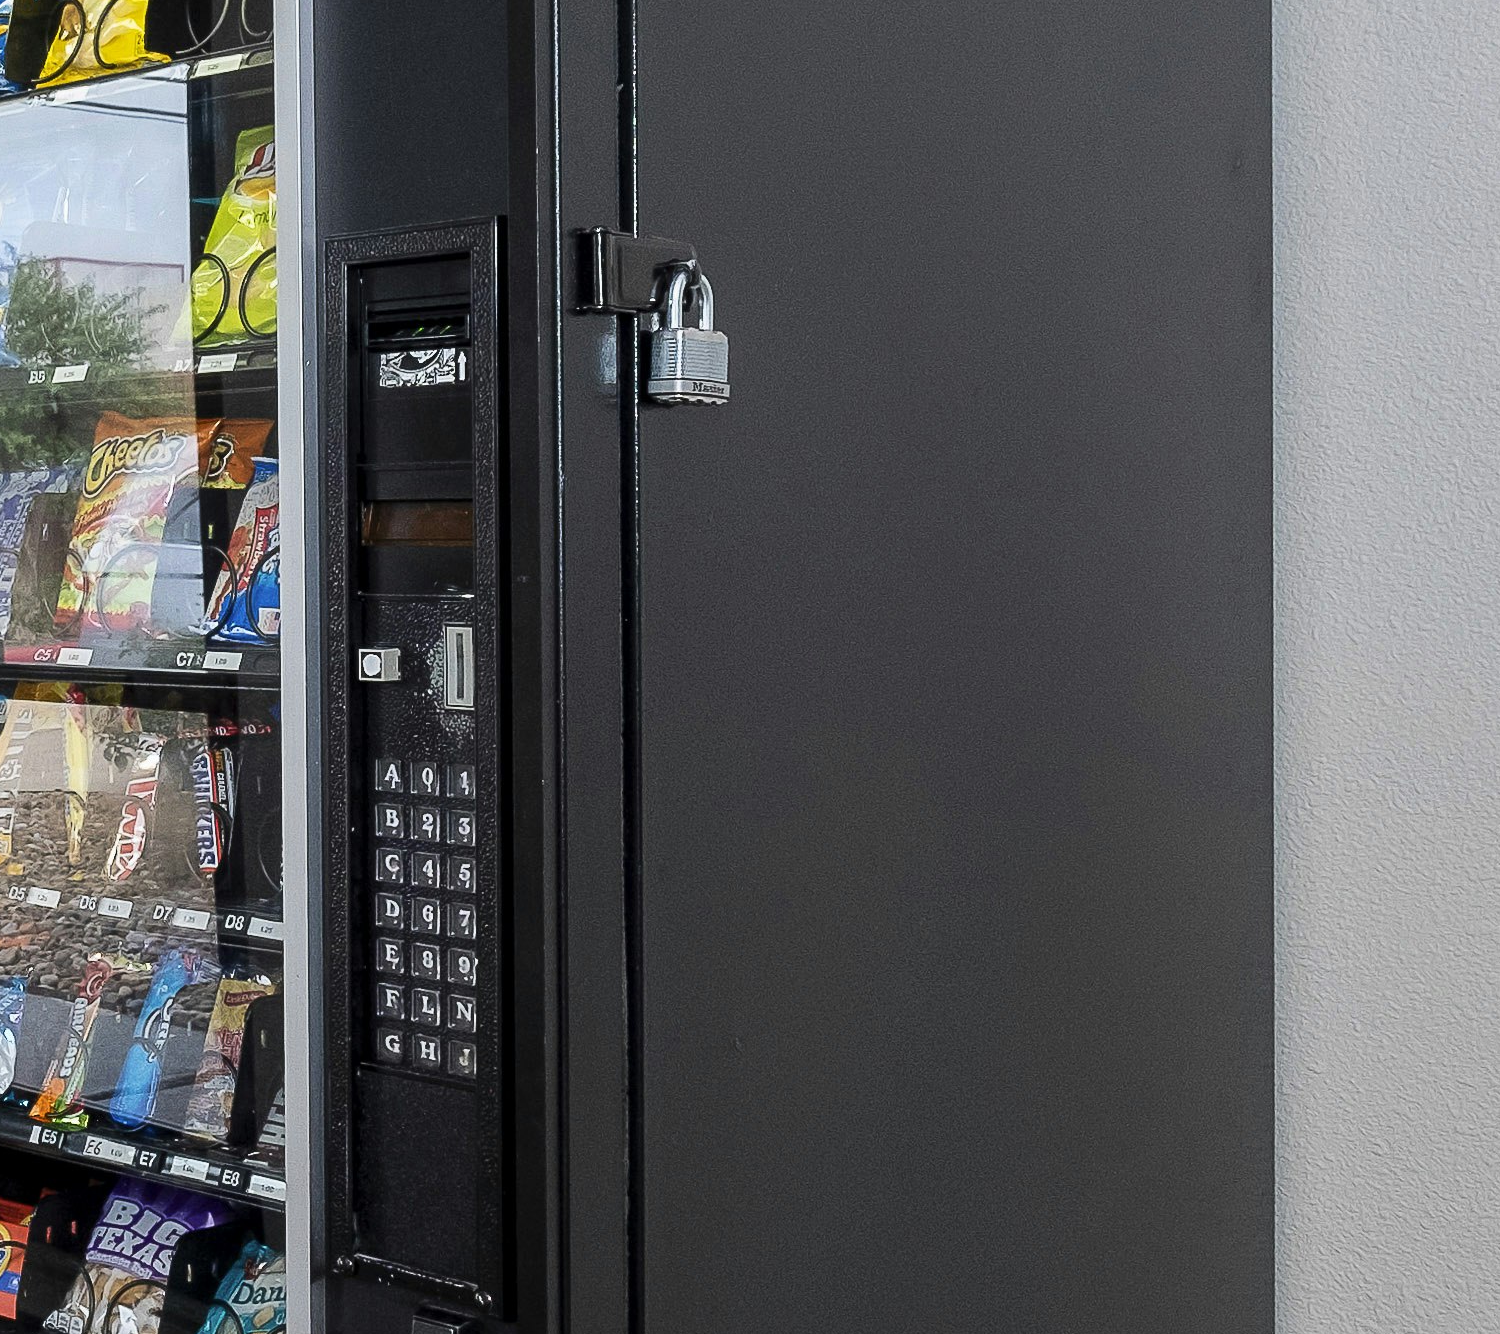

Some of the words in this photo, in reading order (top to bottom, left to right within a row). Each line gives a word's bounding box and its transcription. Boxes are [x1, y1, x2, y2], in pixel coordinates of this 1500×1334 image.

[84, 429, 178, 499] Cheetos
[33, 648, 51, 661] C5
[176, 652, 195, 667] C7
[384, 763, 401, 783] A
[459, 770, 470, 788] 1
[385, 808, 400, 828] B
[421, 813, 434, 831] 2
[458, 817, 471, 835] 3
[384, 854, 400, 873] C
[422, 859, 434, 878] 4
[458, 863, 471, 881] 5
[8, 886, 26, 900] D5
[79, 895, 97, 911] D6
[385, 899, 400, 917] D
[153, 904, 173, 921] D7
[422, 904, 434, 923] 6
[458, 909, 471, 927] 7
[225, 914, 245, 930] D8
[385, 944, 400, 963] E
[422, 950, 434, 969] 8
[458, 956, 471, 974] 9
[385, 988, 400, 1008] F
[421, 995, 435, 1015] L
[456, 1001, 473, 1022] N
[384, 1034, 400, 1054] G
[420, 1040, 436, 1061] H
[459, 1048, 471, 1067] J
[41, 1130, 58, 1145] E5
[85, 1140, 102, 1155] E6
[139, 1150, 157, 1167] E7
[221, 1169, 240, 1186] E8
[102, 1198, 190, 1247] BIG
[90, 1226, 176, 1276] TEXAS
